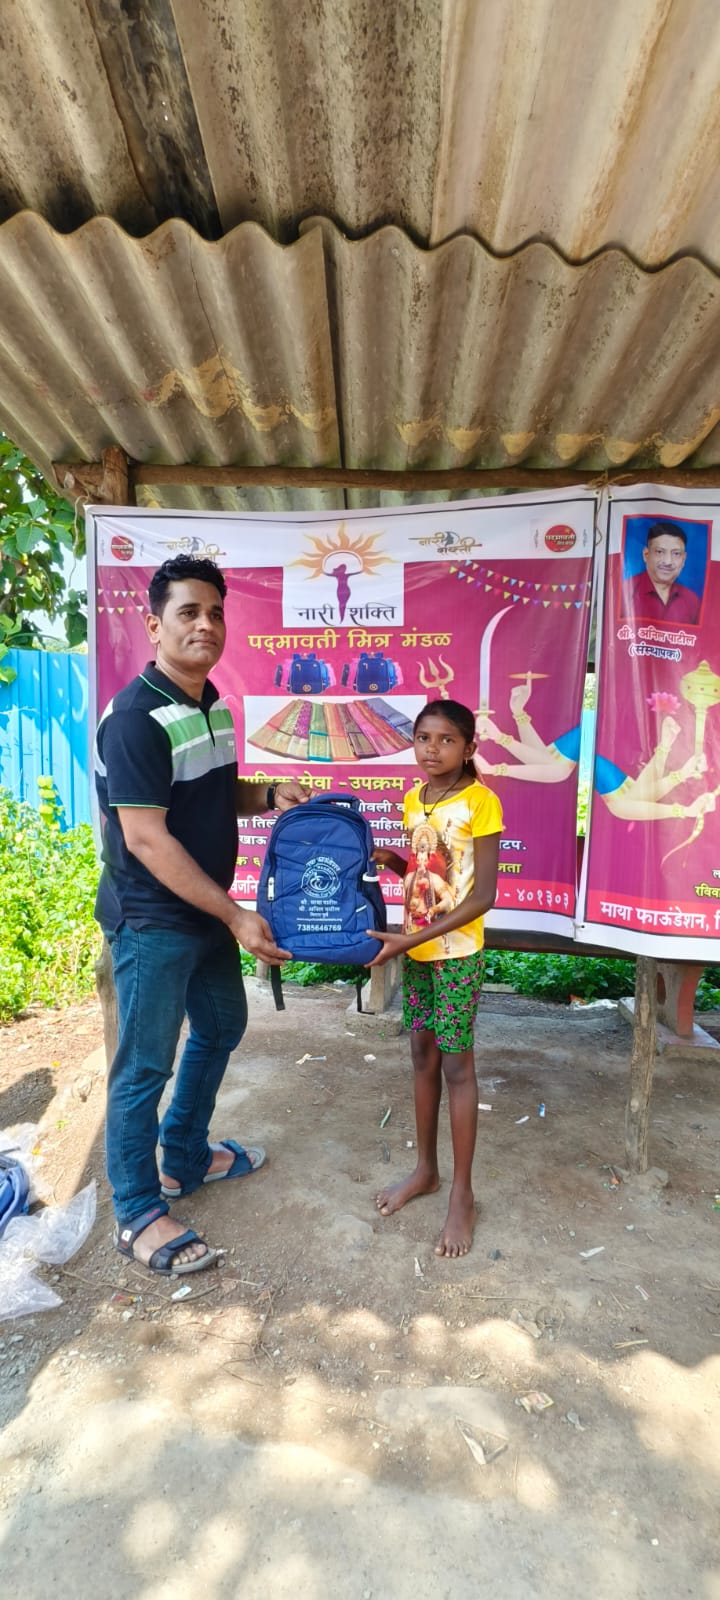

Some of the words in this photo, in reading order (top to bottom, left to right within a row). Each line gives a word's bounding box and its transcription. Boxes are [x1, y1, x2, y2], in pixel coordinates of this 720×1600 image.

[293, 603, 336, 626] नारी
[347, 602, 398, 626] शक्ति
[248, 628, 340, 655] पद्मावती
[347, 629, 393, 648] मित्र
[400, 627, 453, 648] मंडळ
[516, 888, 569, 910] ४०१३०३
[600, 901, 633, 922] माया
